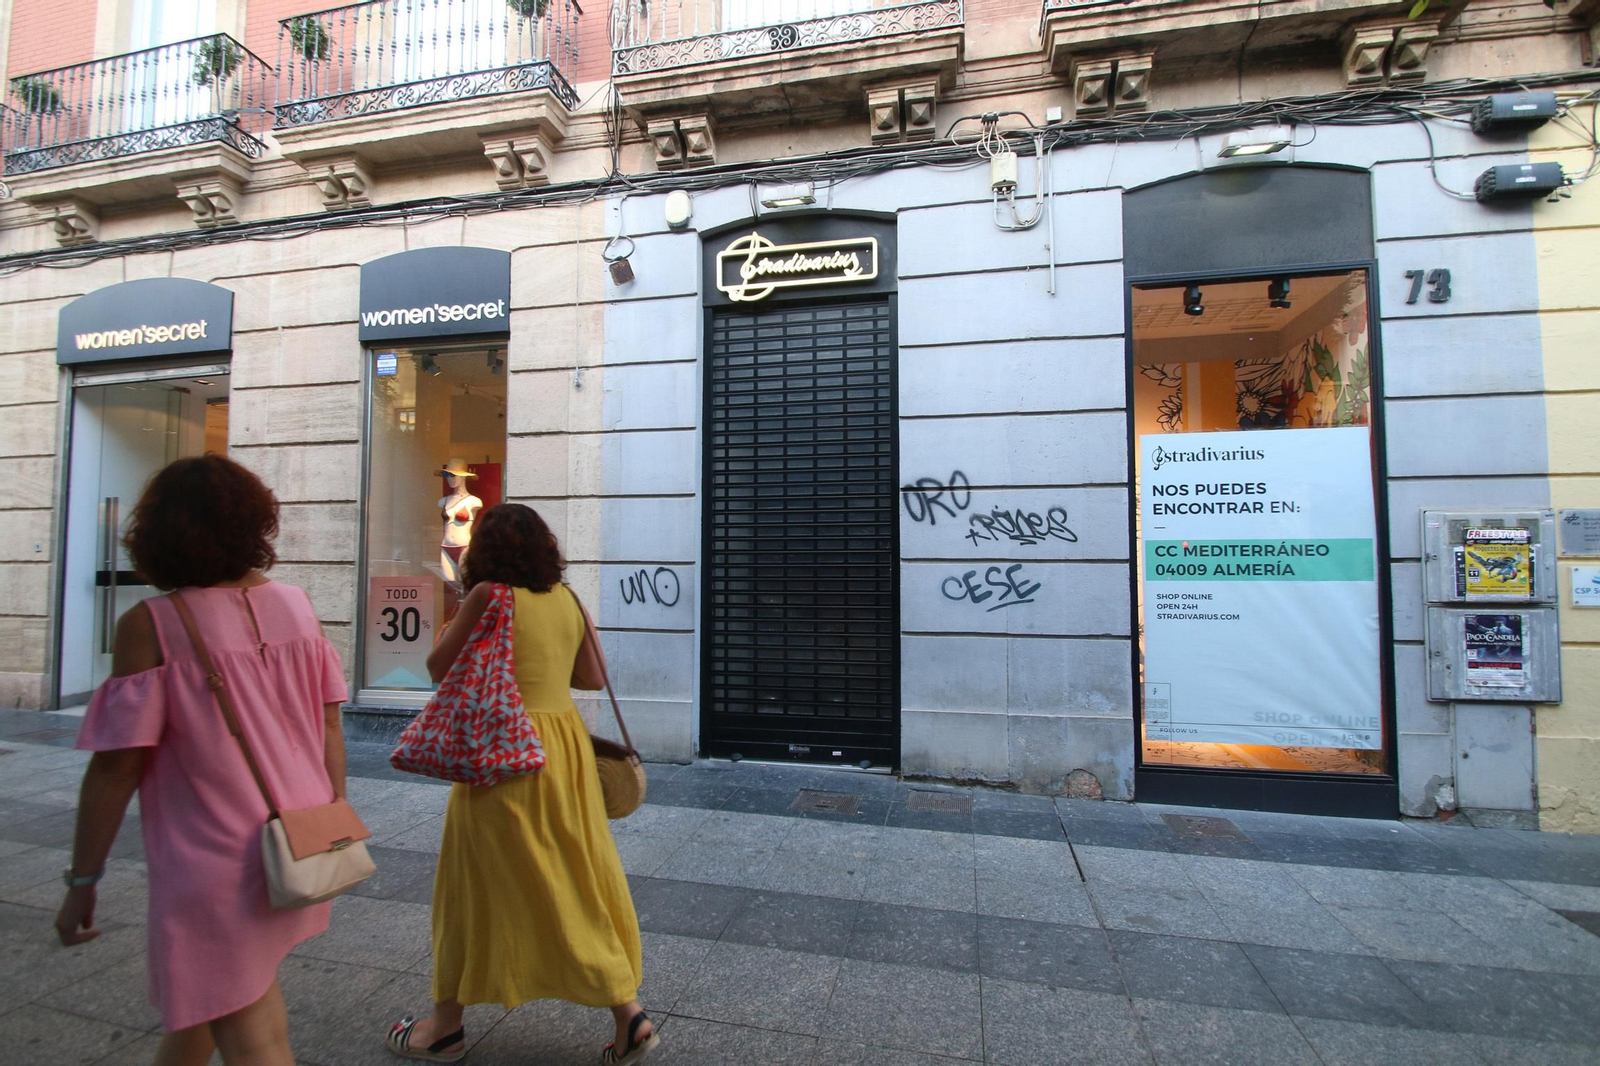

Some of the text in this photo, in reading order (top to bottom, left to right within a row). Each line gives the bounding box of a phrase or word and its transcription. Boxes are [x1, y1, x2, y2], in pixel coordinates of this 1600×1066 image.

[1405, 268, 1452, 305] 73
[362, 299, 505, 327] women'secret
[75, 319, 208, 350] women'secret
[1164, 446, 1265, 463] stradivarius
[1152, 482, 1267, 497] NOS PUEDES
[1153, 501, 1300, 515] ENCONTRAR EN:
[1468, 530, 1526, 538] FREESTYLE
[1154, 541, 1330, 557] CC MEDITERRÁNEO
[1155, 561, 1295, 576] 04009 ALMERÍA
[385, 589, 417, 599] TODO
[1574, 587, 1591, 595] CSP
[1254, 711, 1302, 724] SHOP
